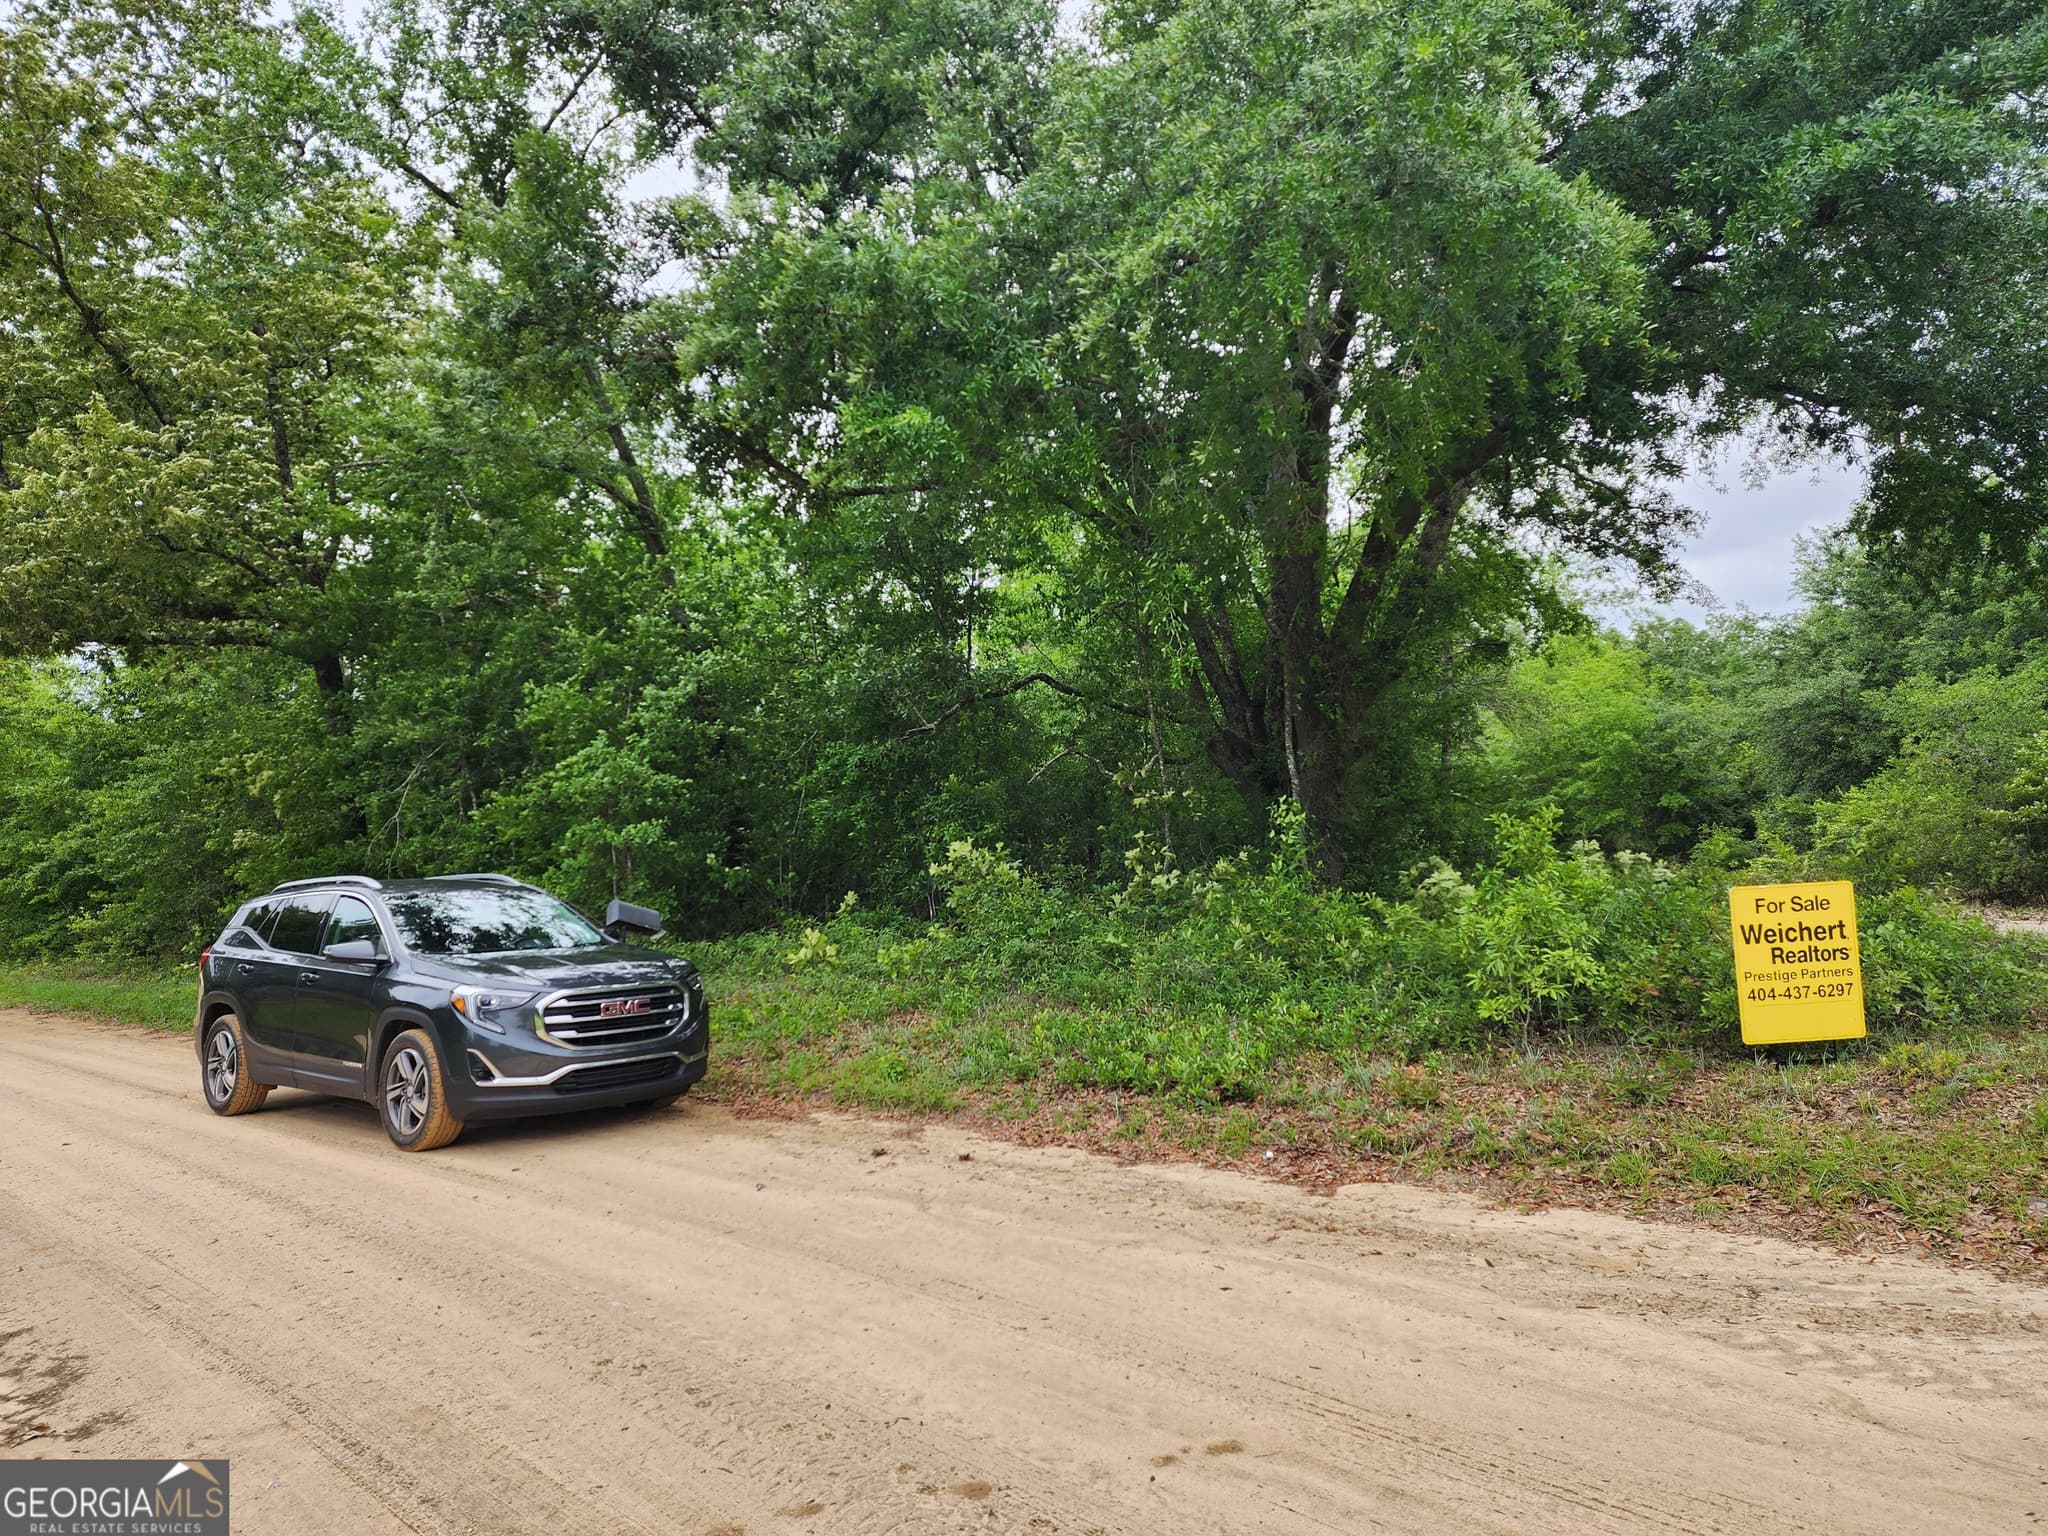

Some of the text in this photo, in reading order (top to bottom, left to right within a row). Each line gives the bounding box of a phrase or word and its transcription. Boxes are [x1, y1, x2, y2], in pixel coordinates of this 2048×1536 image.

[1755, 895, 1831, 914] For Sale
[1744, 966, 1854, 982] Prestige Partners
[1747, 983, 1854, 1001] 404-437-6297
[600, 998, 651, 1017] GMC
